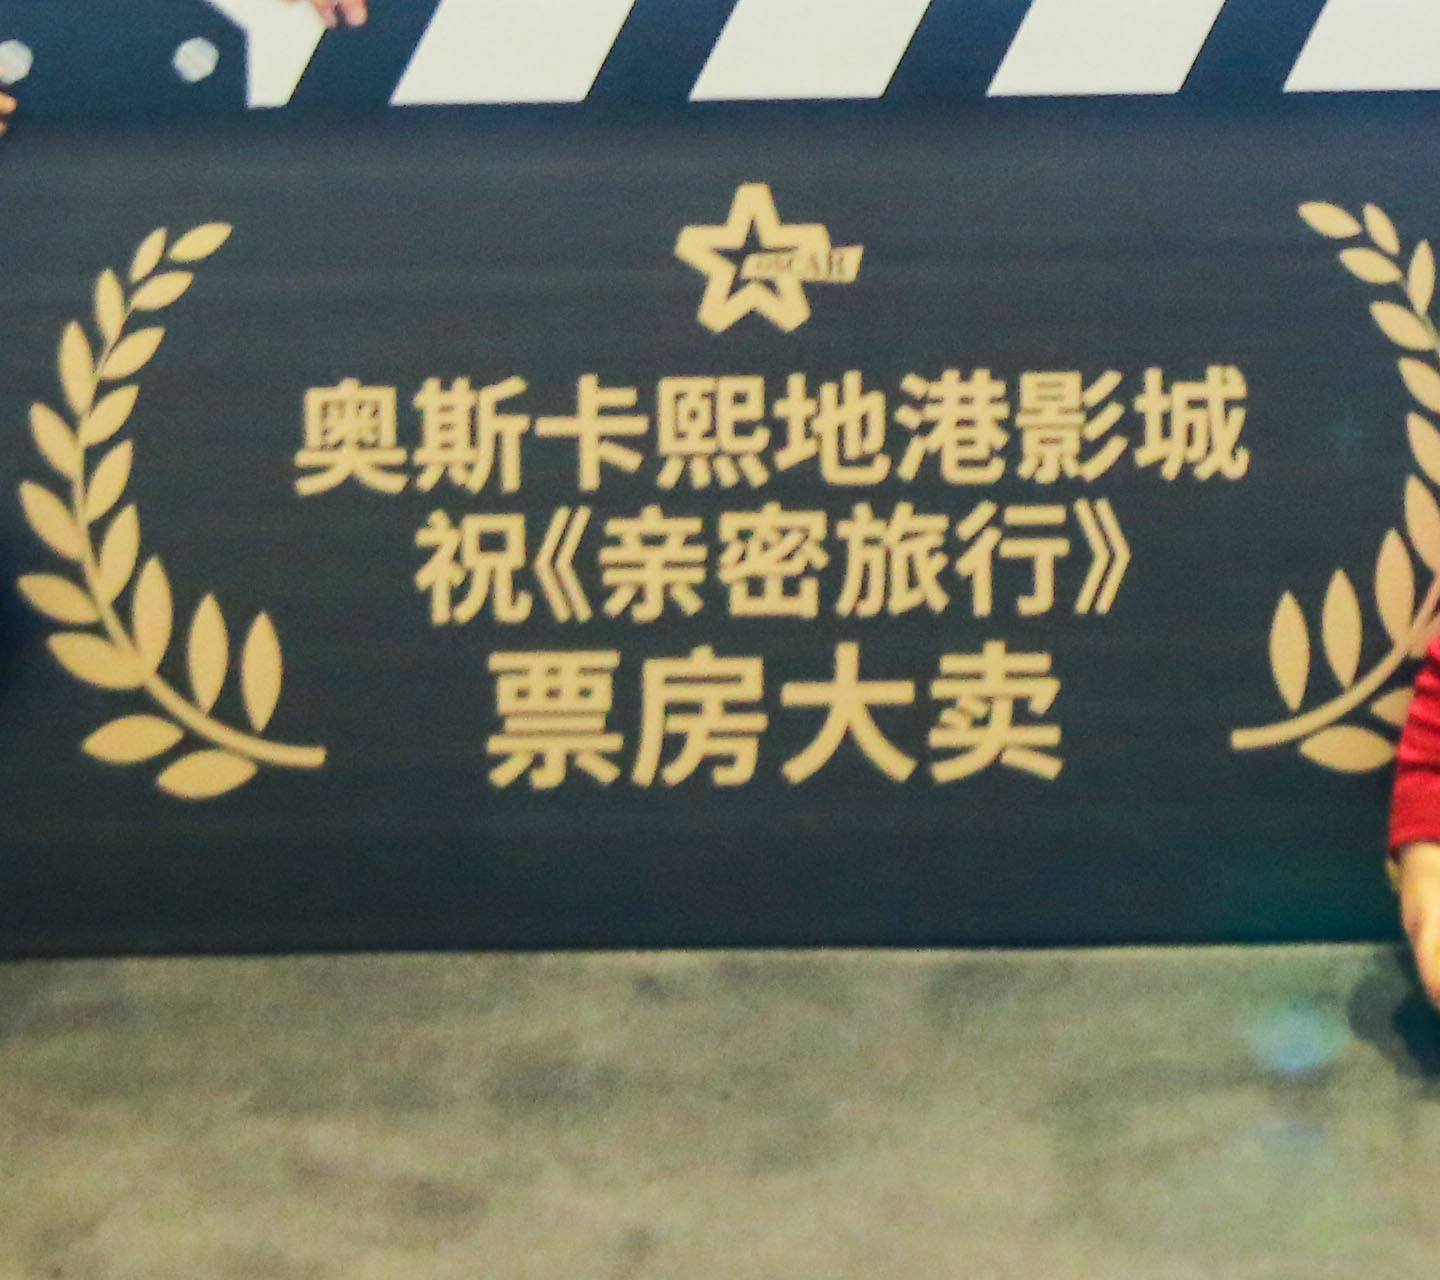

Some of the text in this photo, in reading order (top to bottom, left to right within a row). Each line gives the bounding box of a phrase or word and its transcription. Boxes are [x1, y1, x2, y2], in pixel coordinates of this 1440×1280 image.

[294, 363, 1251, 496] 奥斯卡熙地港影城
[414, 497, 1131, 627] 祝《亲密旅行》
[486, 640, 1063, 790] 票房大卖
